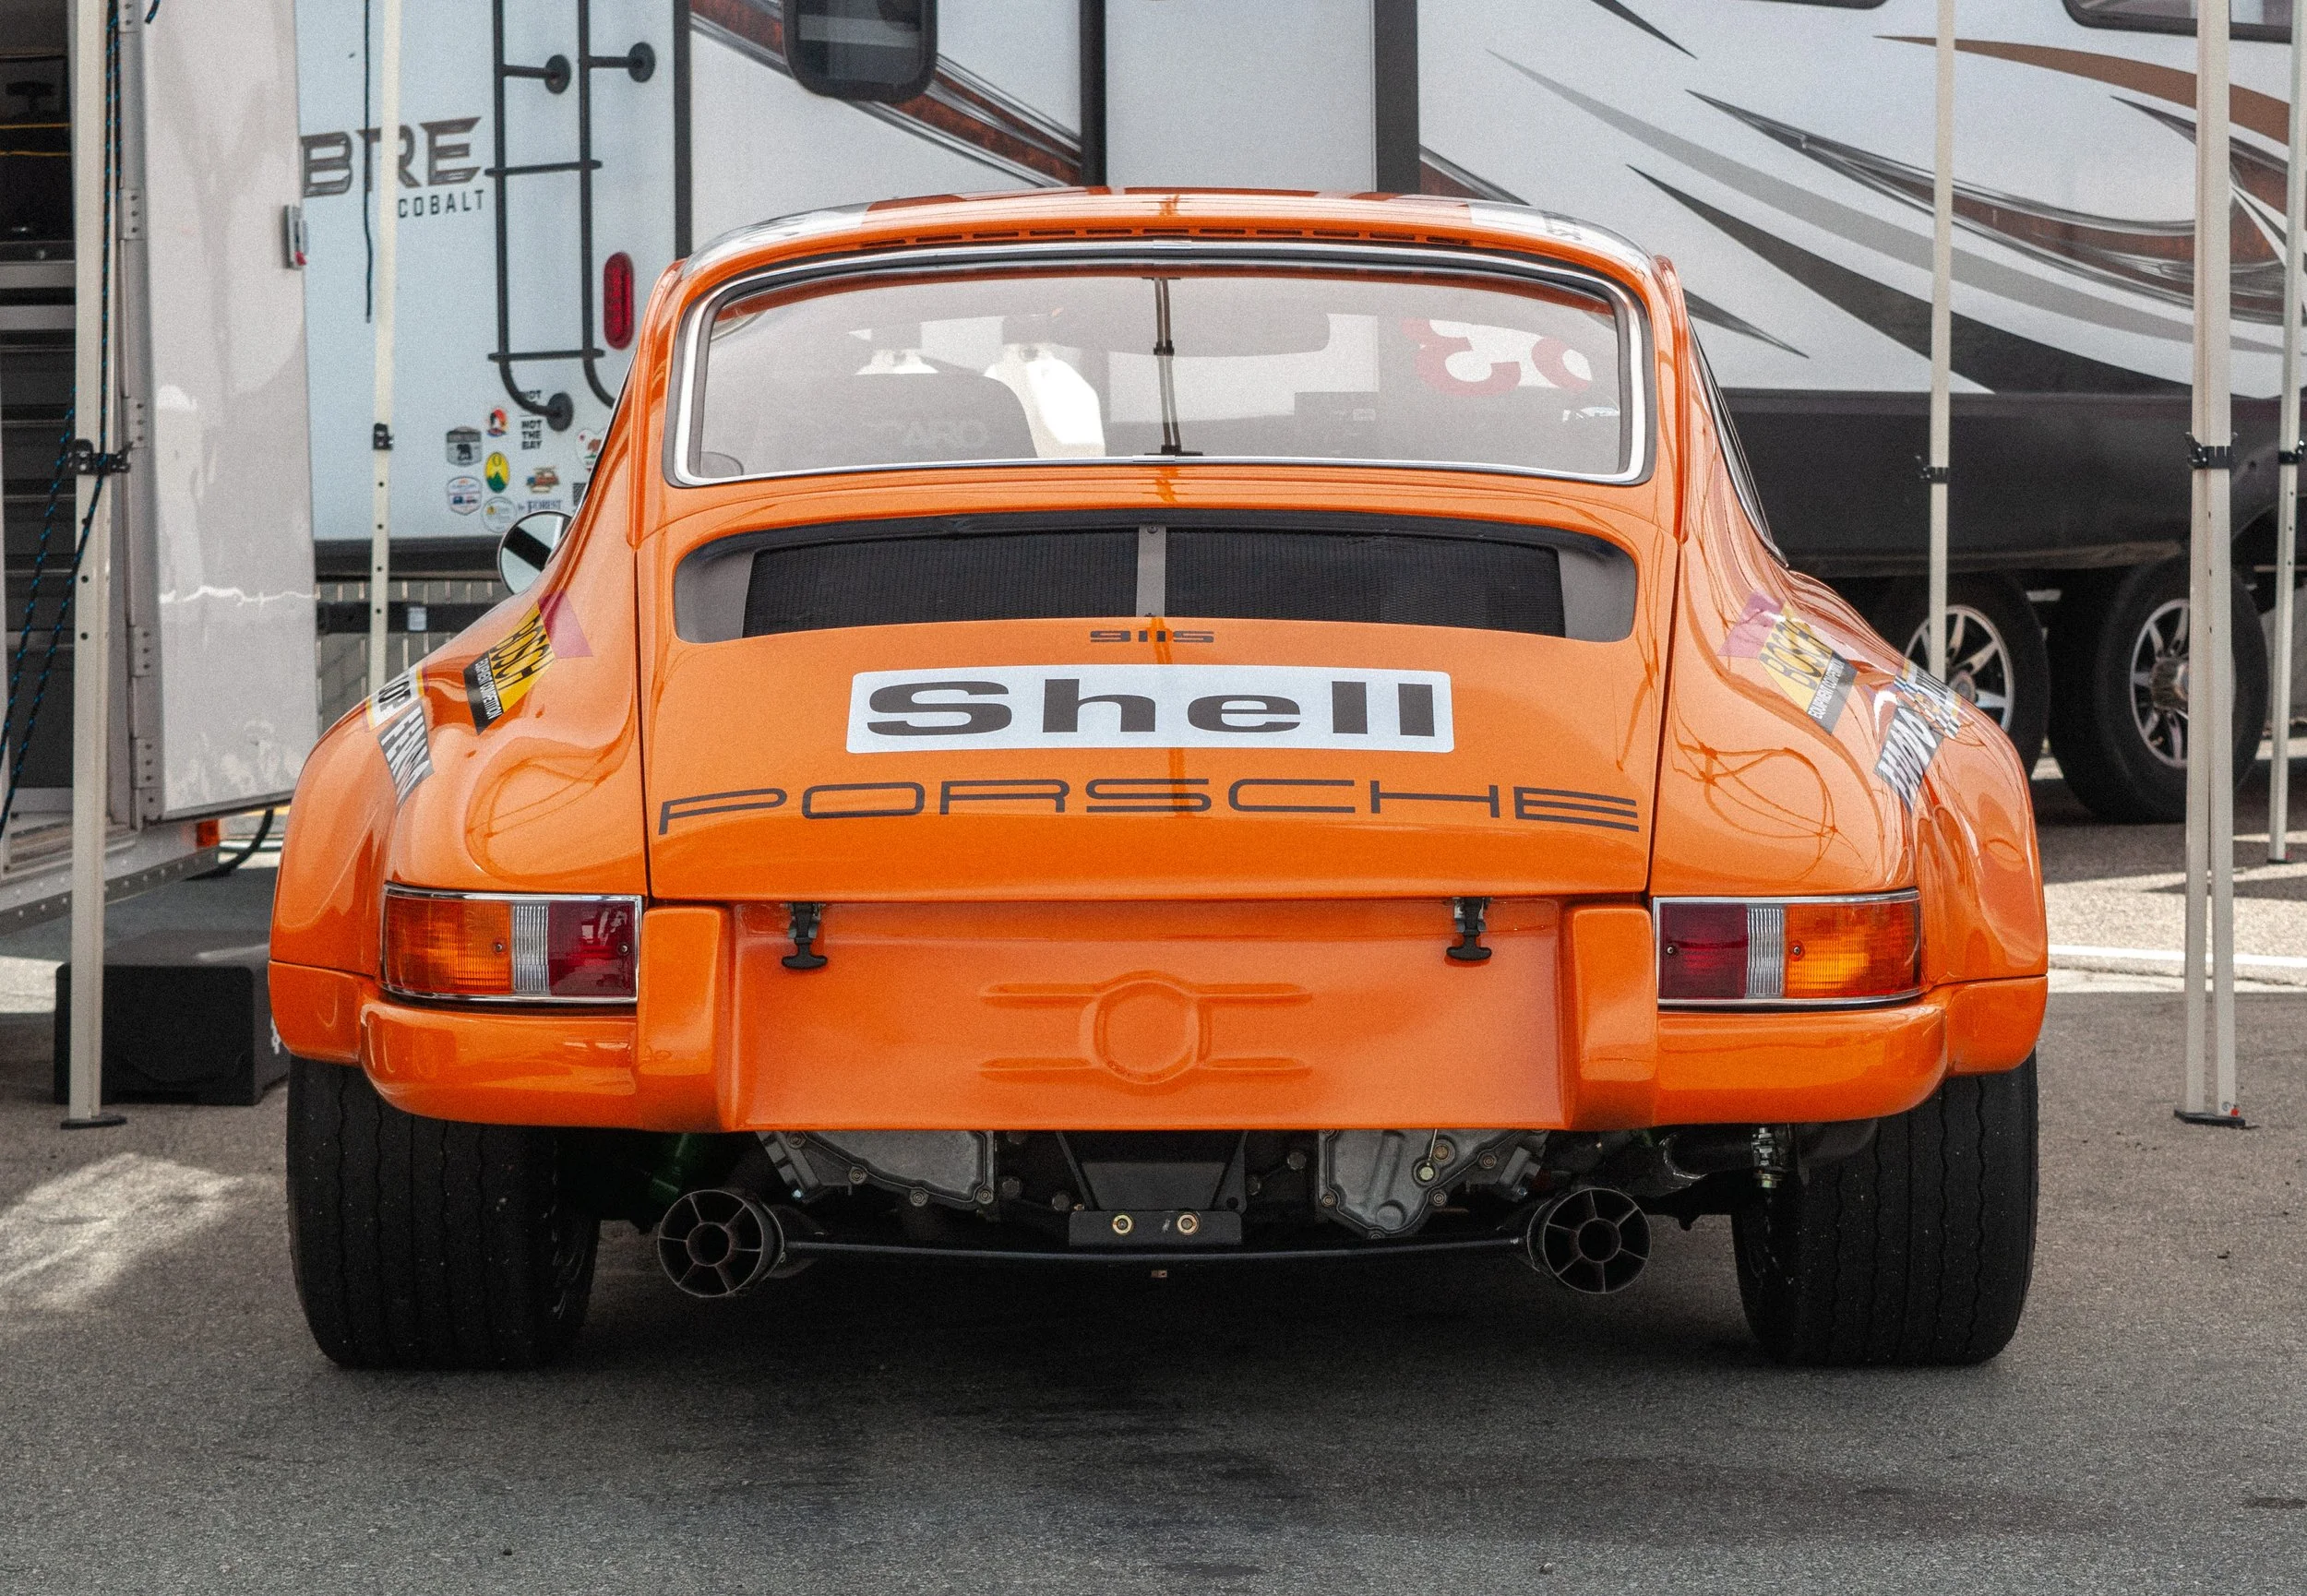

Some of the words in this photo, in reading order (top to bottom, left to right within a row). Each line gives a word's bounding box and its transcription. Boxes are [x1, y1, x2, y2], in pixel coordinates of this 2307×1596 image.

[398, 189, 484, 219] COBALT
[521, 420, 542, 429] NOT
[521, 440, 543, 450] BAY
[522, 430, 542, 439] THE
[489, 614, 555, 691] BOSCH
[1759, 619, 1832, 691] BOSCH
[480, 681, 504, 720] COMPETITION
[867, 678, 1435, 737] Shell
[379, 705, 431, 806] FERODO
[1878, 708, 1938, 813] FERODO
[658, 778, 1640, 836] PORSCHE
